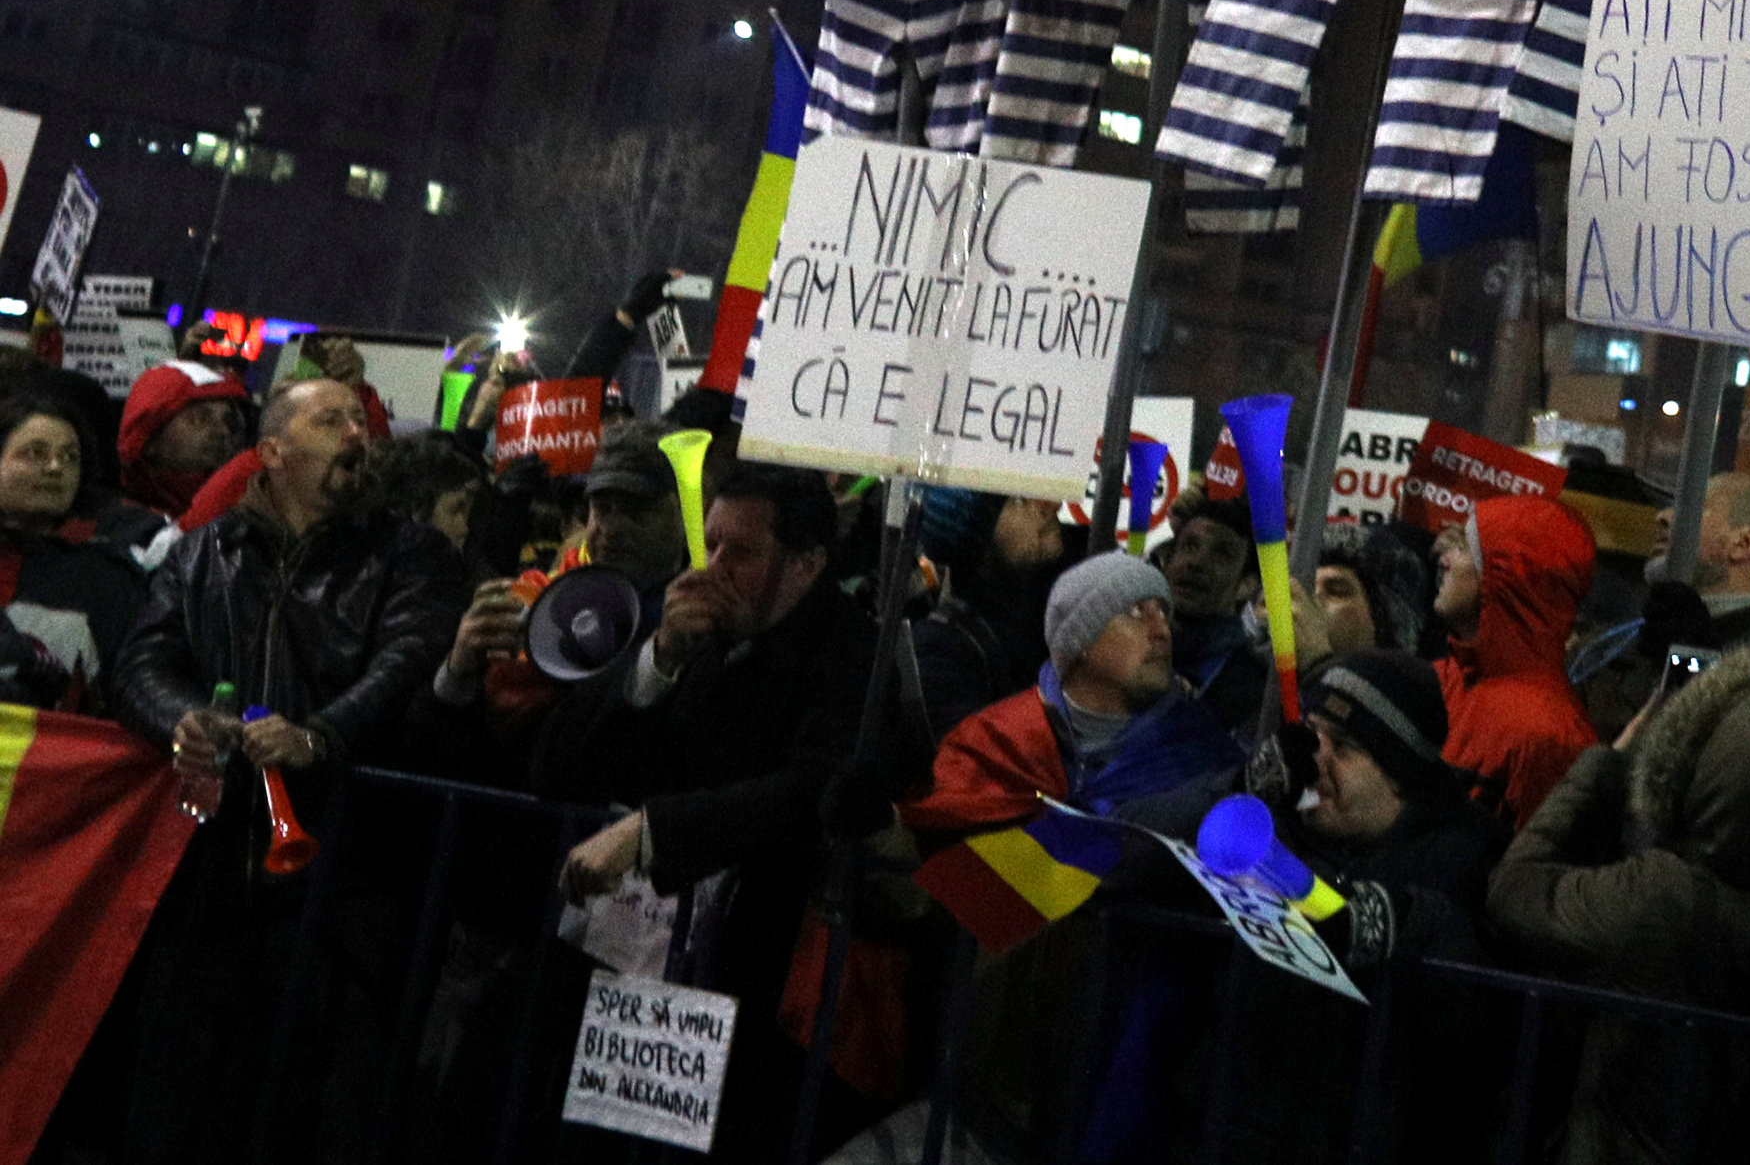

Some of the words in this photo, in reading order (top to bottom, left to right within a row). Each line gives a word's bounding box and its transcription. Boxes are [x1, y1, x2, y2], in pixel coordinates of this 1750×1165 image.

[1578, 136, 1651, 202] AM
[772, 257, 838, 329] AM
[850, 265, 963, 339] VENIT
[967, 282, 1012, 349] LA
[1014, 287, 1127, 359] FURAT
[874, 364, 913, 427] E
[932, 372, 1073, 457] LEGAL
[1406, 477, 1476, 513] ORDO
[596, 986, 642, 1025] SPER
[584, 1026, 705, 1084] BIBLIOTECA
[617, 1075, 708, 1124] ALEXANDRIA
